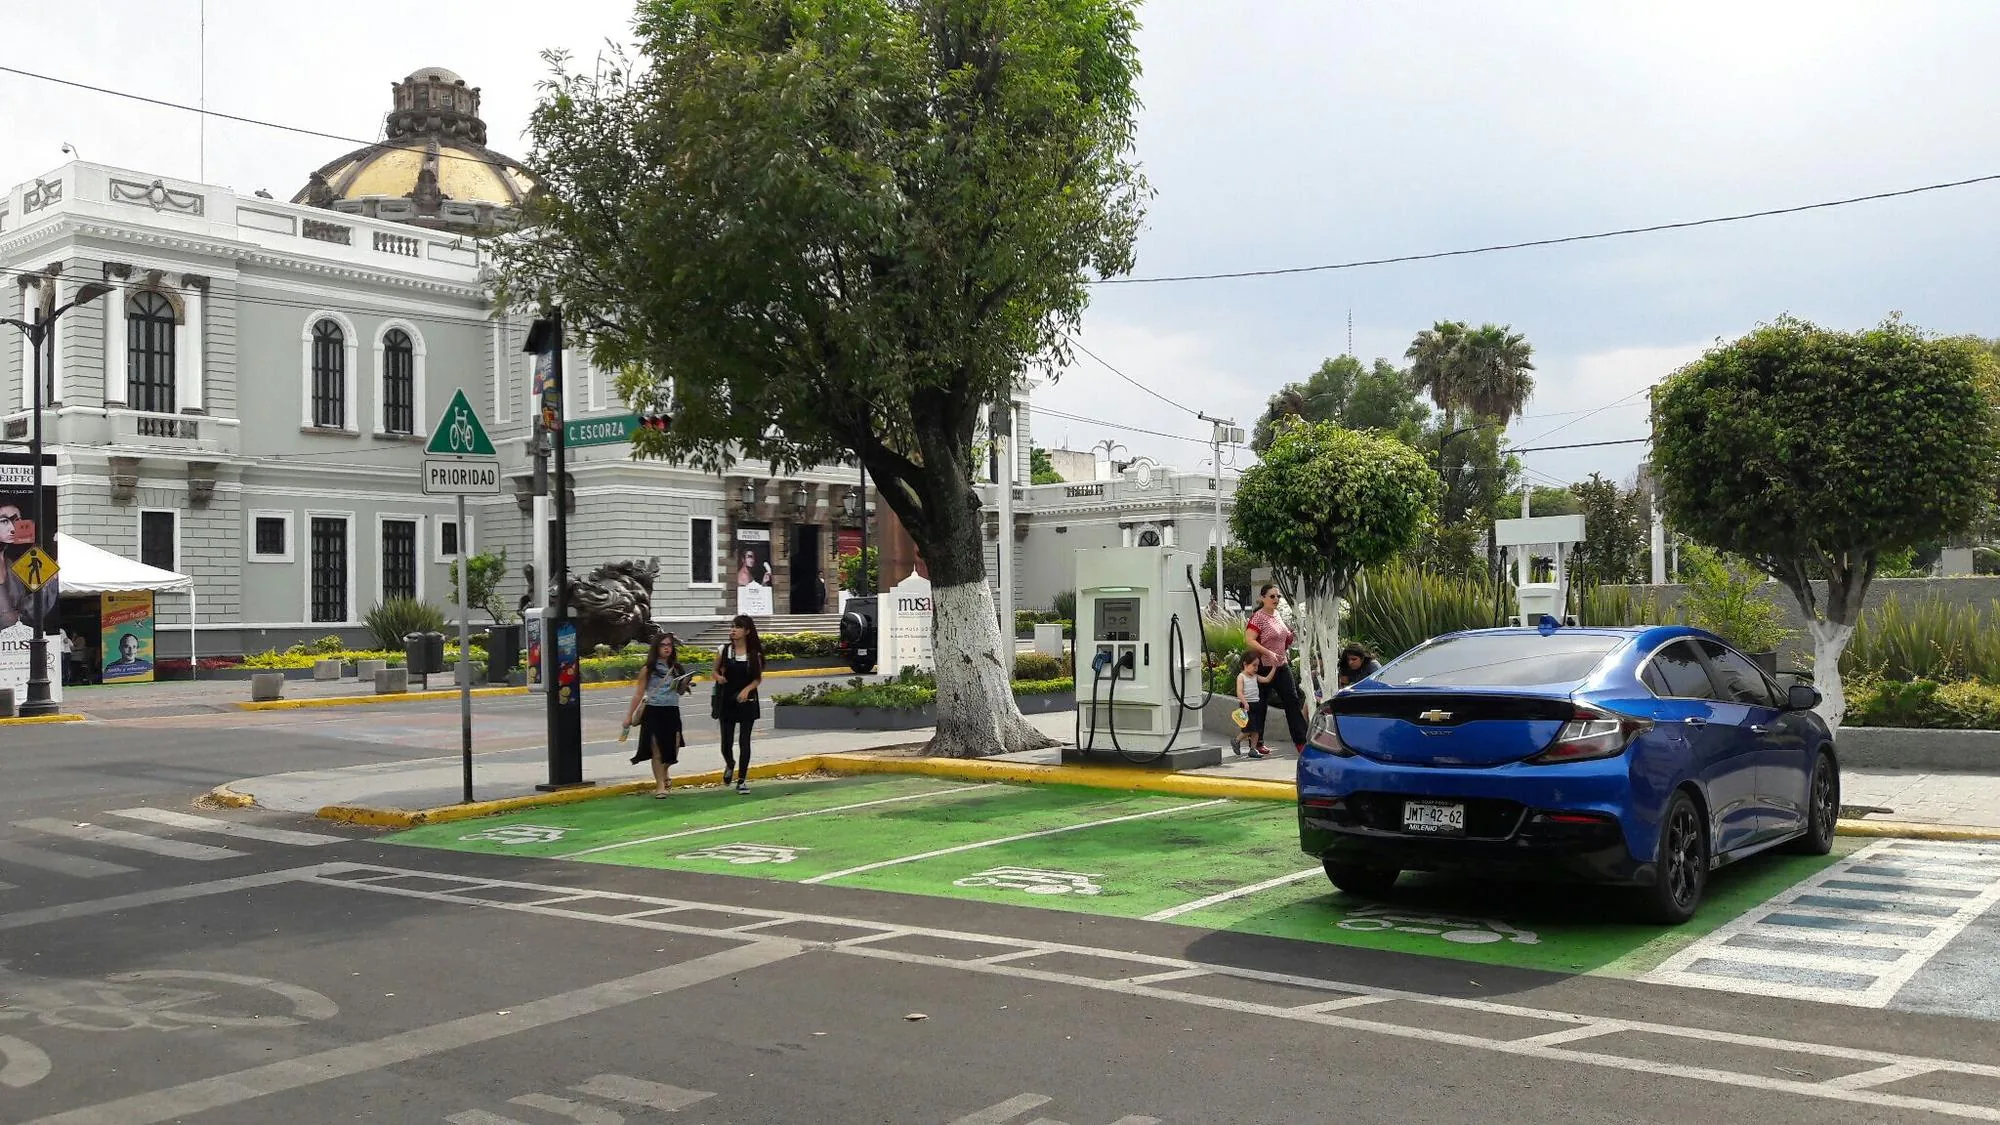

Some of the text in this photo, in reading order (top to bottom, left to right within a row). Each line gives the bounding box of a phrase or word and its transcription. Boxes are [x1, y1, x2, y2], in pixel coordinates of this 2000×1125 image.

[569, 422, 624, 441] C. ESCORZA
[0, 467, 34, 475] UTUR
[431, 468, 495, 486] PRIORIDAD
[0, 475, 34, 483] ERFEC
[898, 597, 931, 611] musa
[2, 639, 31, 651] mus
[1406, 806, 1462, 824] JMT-42-62
[1408, 823, 1438, 832] MILENIO
